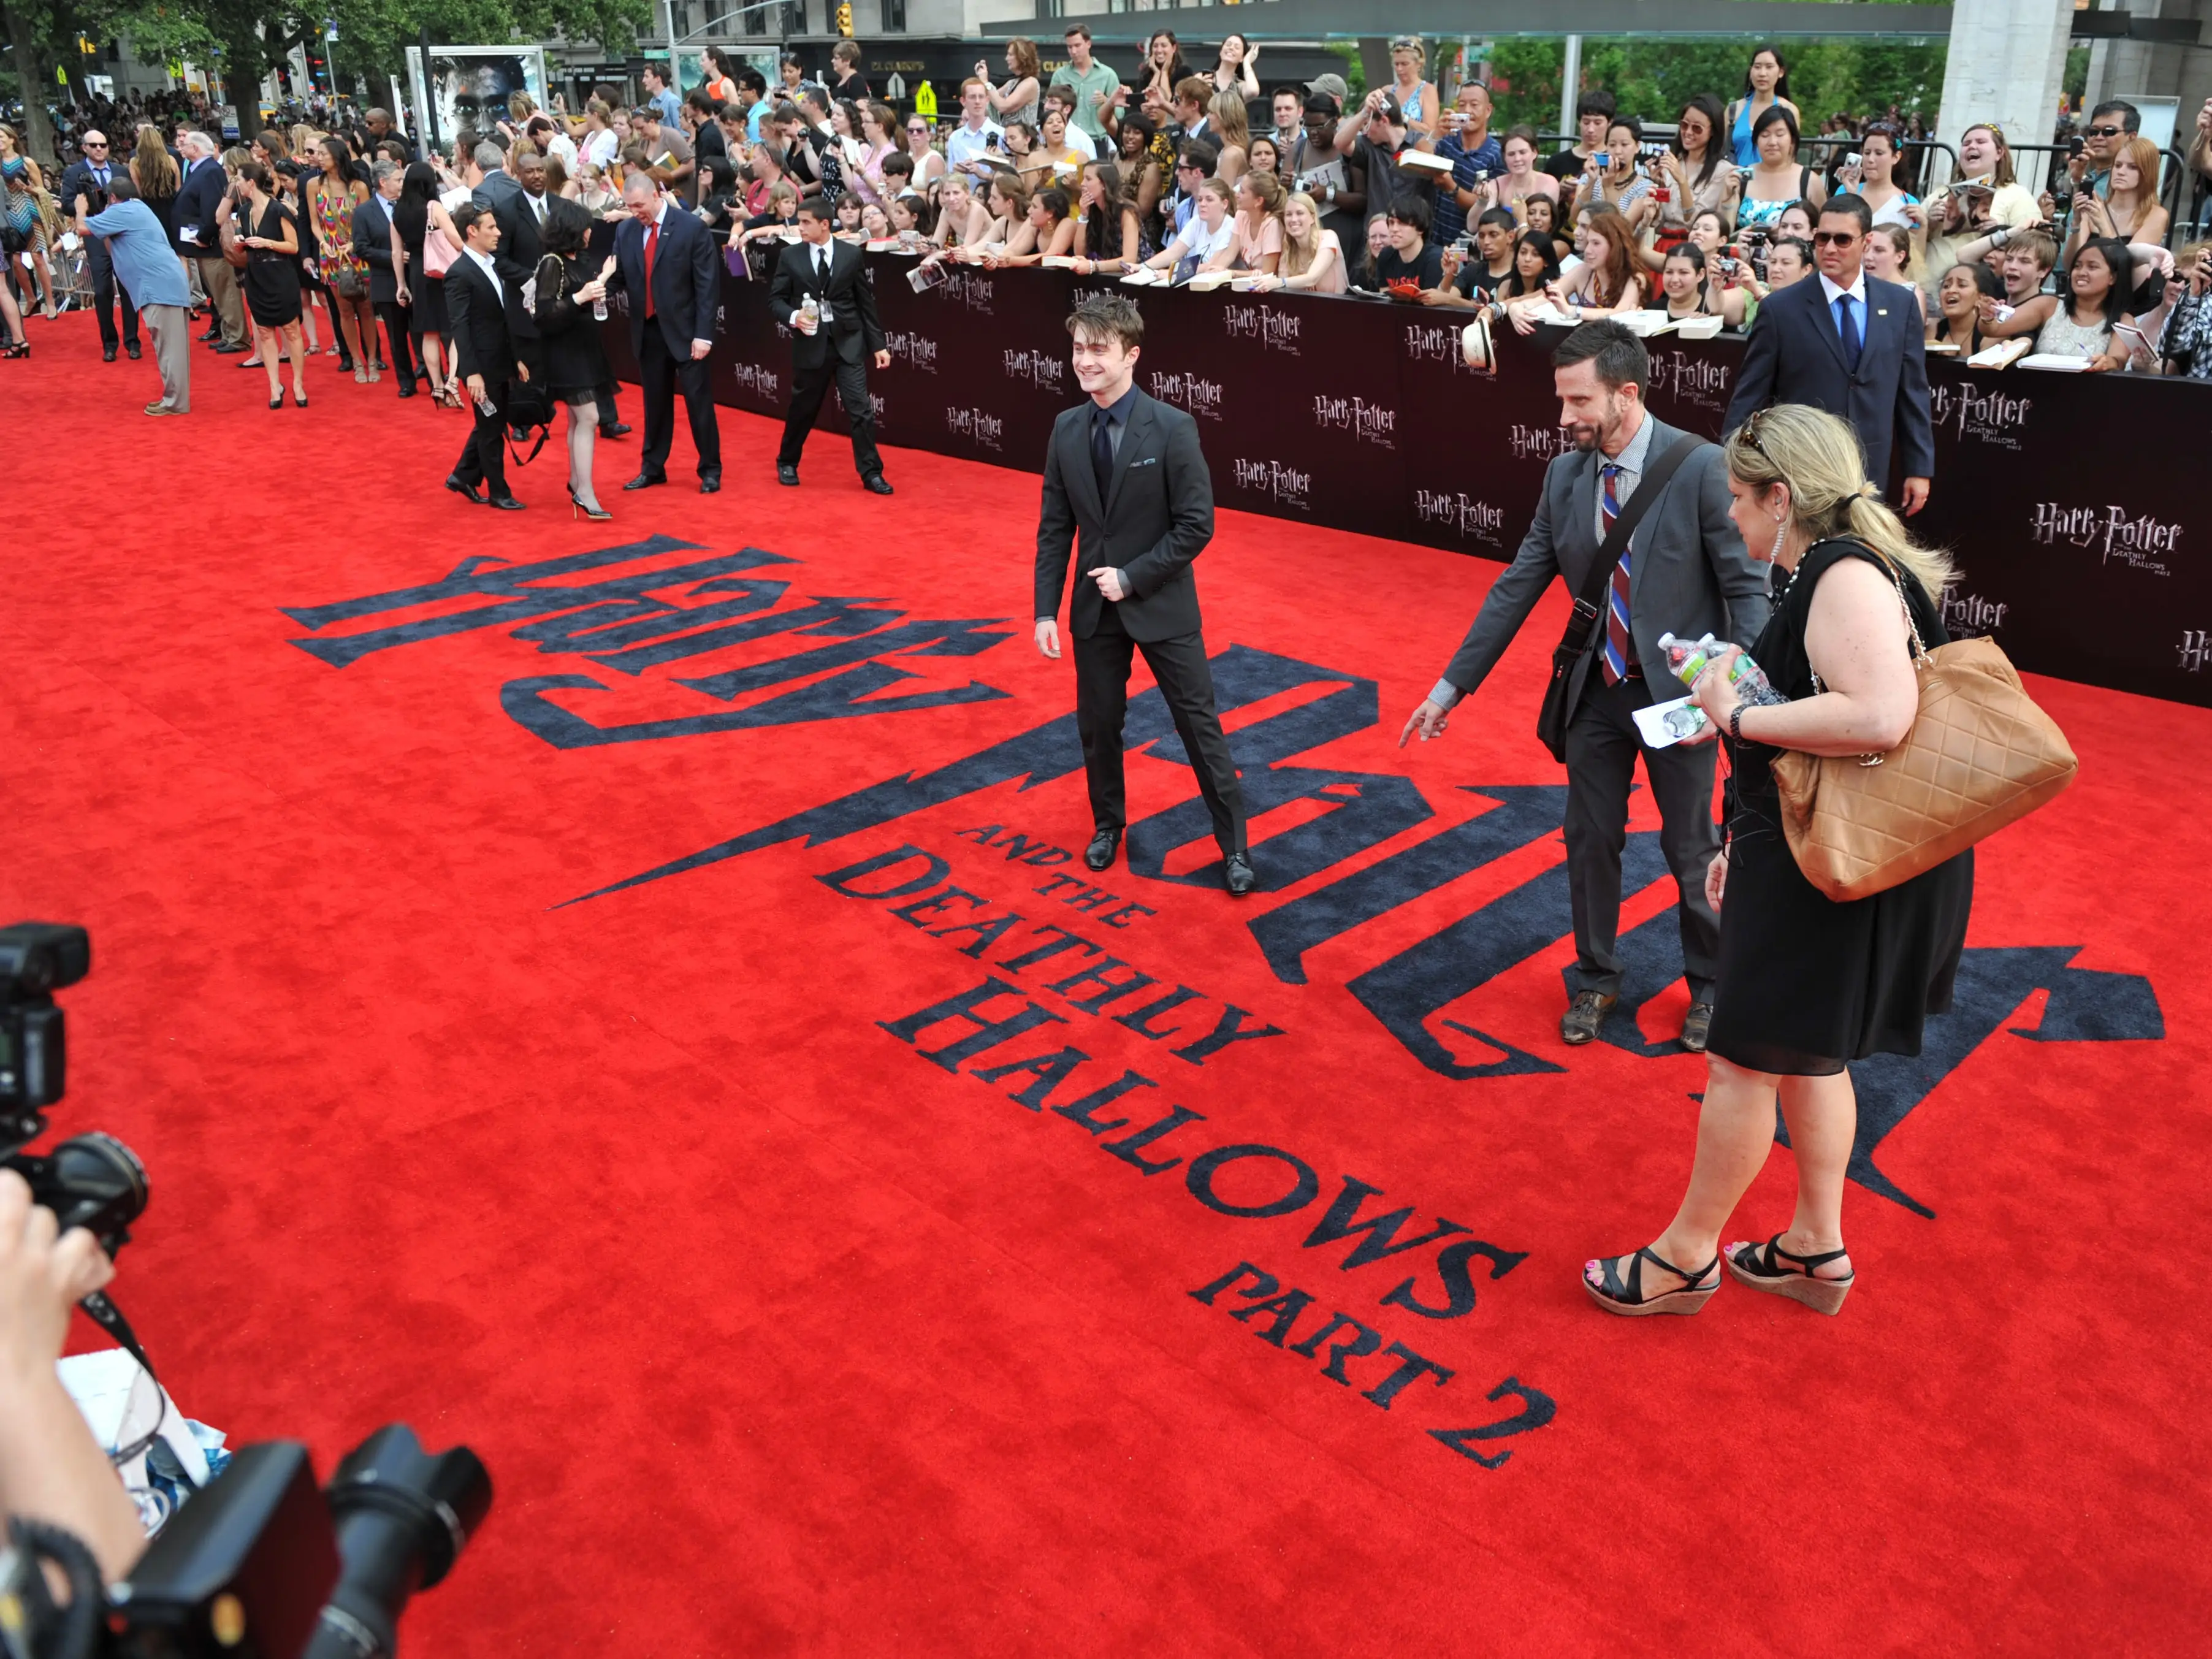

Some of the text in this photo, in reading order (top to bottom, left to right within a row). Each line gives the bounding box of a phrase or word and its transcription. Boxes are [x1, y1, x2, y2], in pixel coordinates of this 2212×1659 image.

[963, 271, 993, 311] Potter
[1223, 304, 1302, 350] Harry Potter
[1405, 325, 1450, 360] Harry
[885, 332, 910, 360] Harry
[909, 332, 937, 370] Potter
[1002, 349, 1032, 378] Harry
[1031, 349, 1064, 389] Potter
[1150, 372, 1223, 416] Harry Potter
[1671, 351, 1731, 404] Potter
[946, 407, 974, 435] Harry
[972, 408, 1002, 446] Potter
[1313, 395, 1396, 442] Harry Potter
[1958, 382, 2033, 442] Potter
[1508, 424, 1557, 462] Harry
[1233, 459, 1311, 503] Harry Potter
[1414, 490, 1504, 538] Harry Potter
[2029, 502, 2184, 566] Harry Potter
[2129, 557, 2165, 571] HALLOWS
[1939, 582, 2009, 630] Potter
[956, 825, 1157, 929] AND THE
[814, 843, 1288, 1066] DEATHLY
[875, 976, 1529, 1319] HALLOWS
[1187, 1261, 1557, 1470] PART 2
